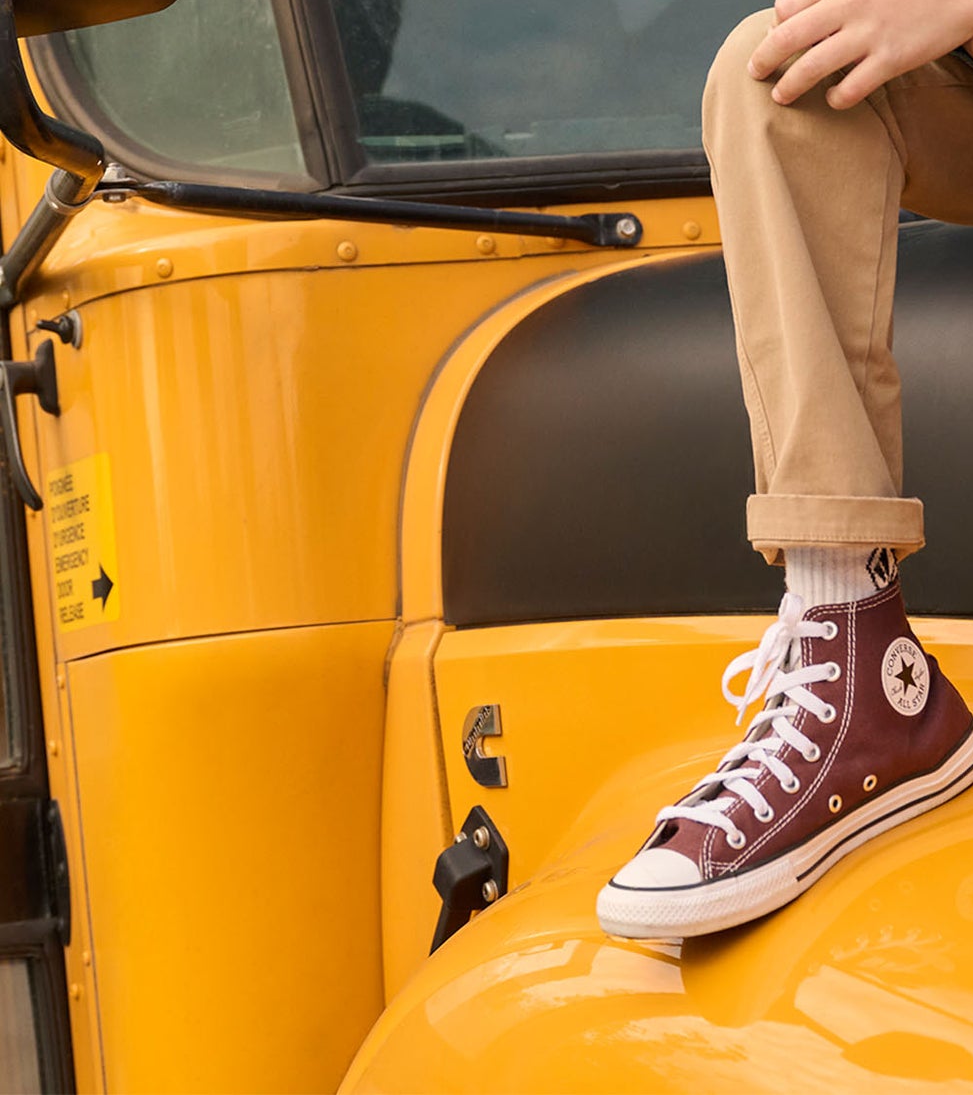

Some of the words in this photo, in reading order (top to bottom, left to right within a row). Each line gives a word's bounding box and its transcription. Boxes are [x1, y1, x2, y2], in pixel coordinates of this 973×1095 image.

[55, 548, 89, 574] EMERGENCY
[57, 579, 73, 599] DOOR
[59, 602, 84, 623] RELEASE
[886, 644, 917, 676] CONVERSE
[897, 697, 911, 709] ALL
[912, 683, 925, 707] STAR
